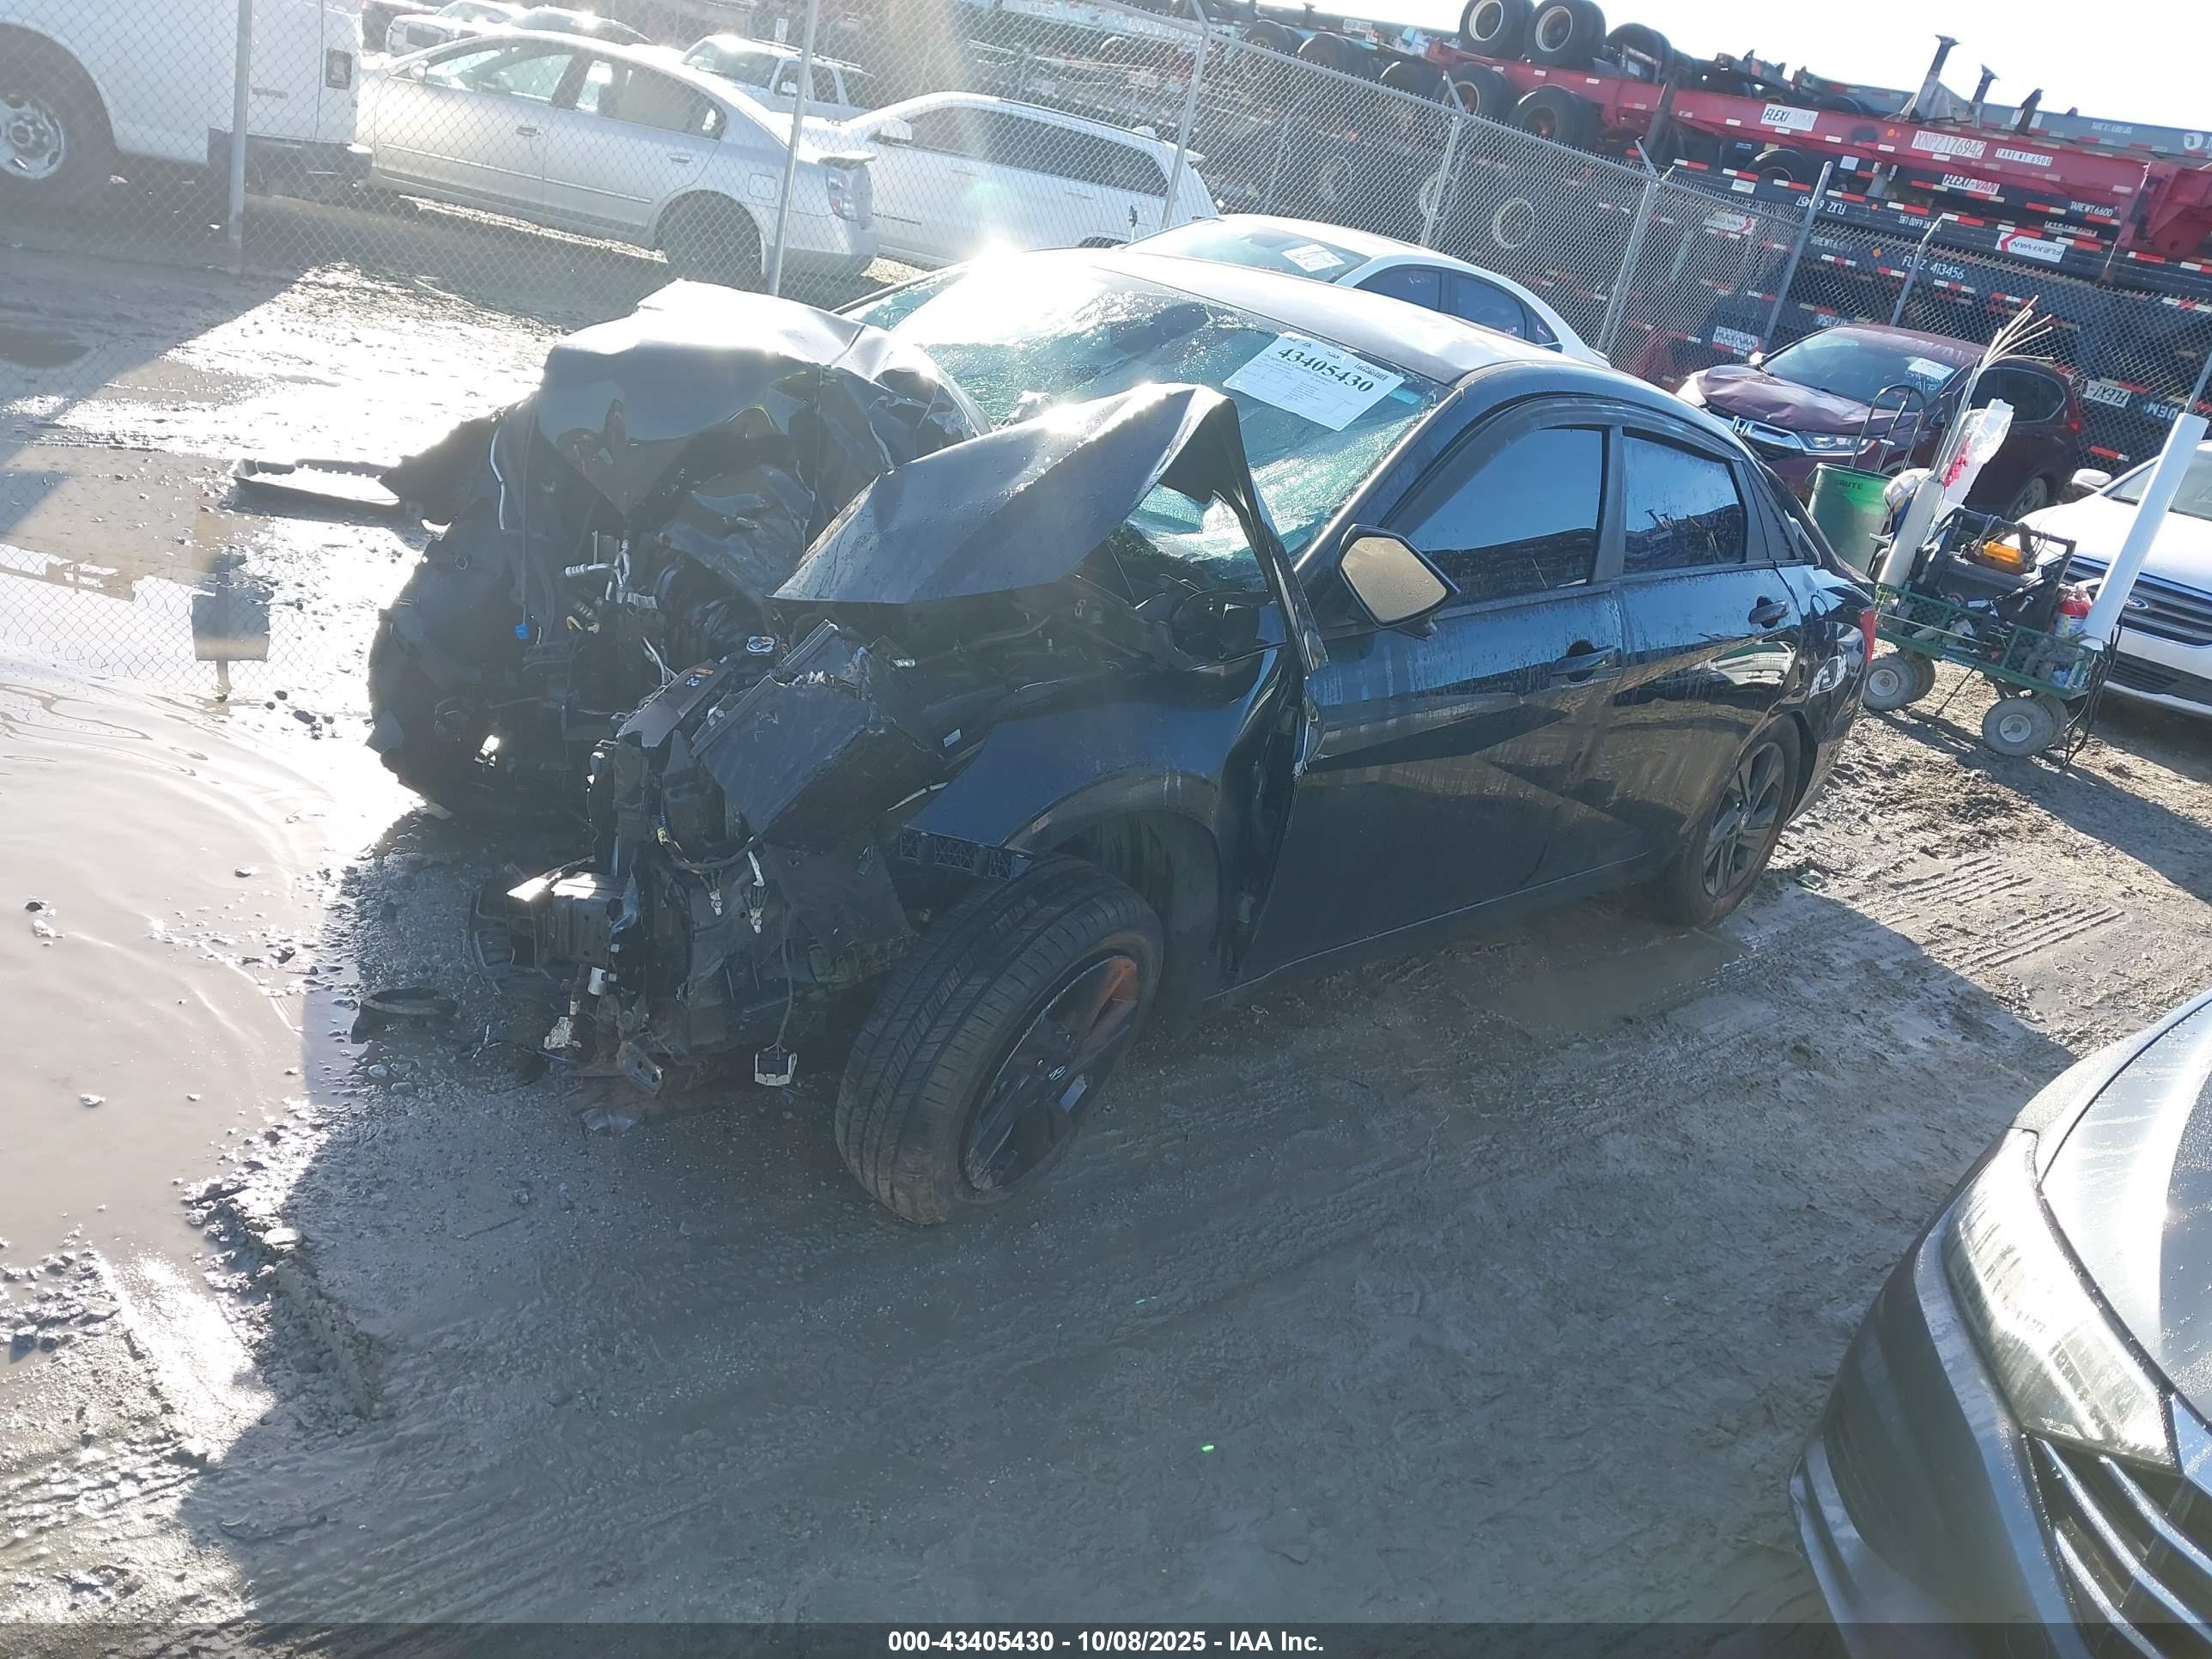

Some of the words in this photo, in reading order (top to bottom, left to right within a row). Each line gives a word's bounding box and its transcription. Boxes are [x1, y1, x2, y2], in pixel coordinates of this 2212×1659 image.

[1901, 255, 1925, 270] FLZ
[1929, 262, 1966, 280] 413456
[1278, 349, 1375, 392] 43405430
